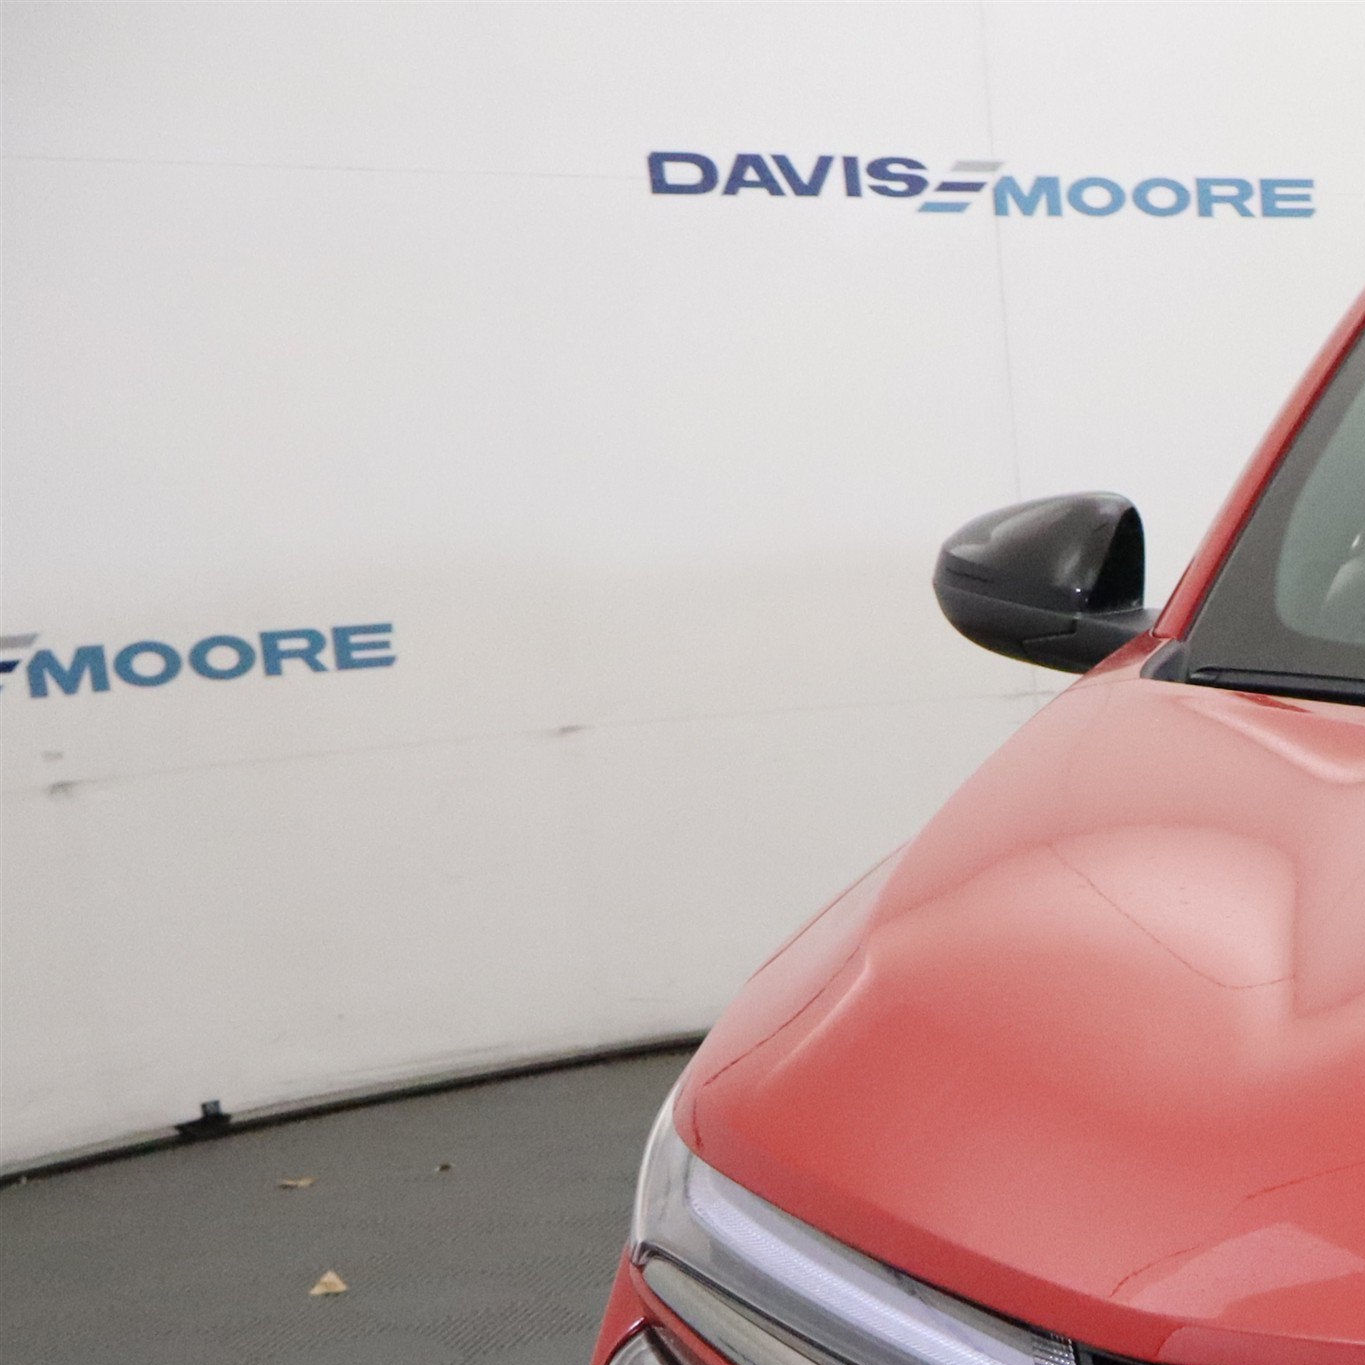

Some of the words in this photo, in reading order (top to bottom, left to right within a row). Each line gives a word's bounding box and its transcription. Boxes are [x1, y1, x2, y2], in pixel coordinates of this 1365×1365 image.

[648, 151, 927, 198] DAVIS
[992, 175, 1315, 218] MOORE
[27, 622, 396, 698] MOORE
